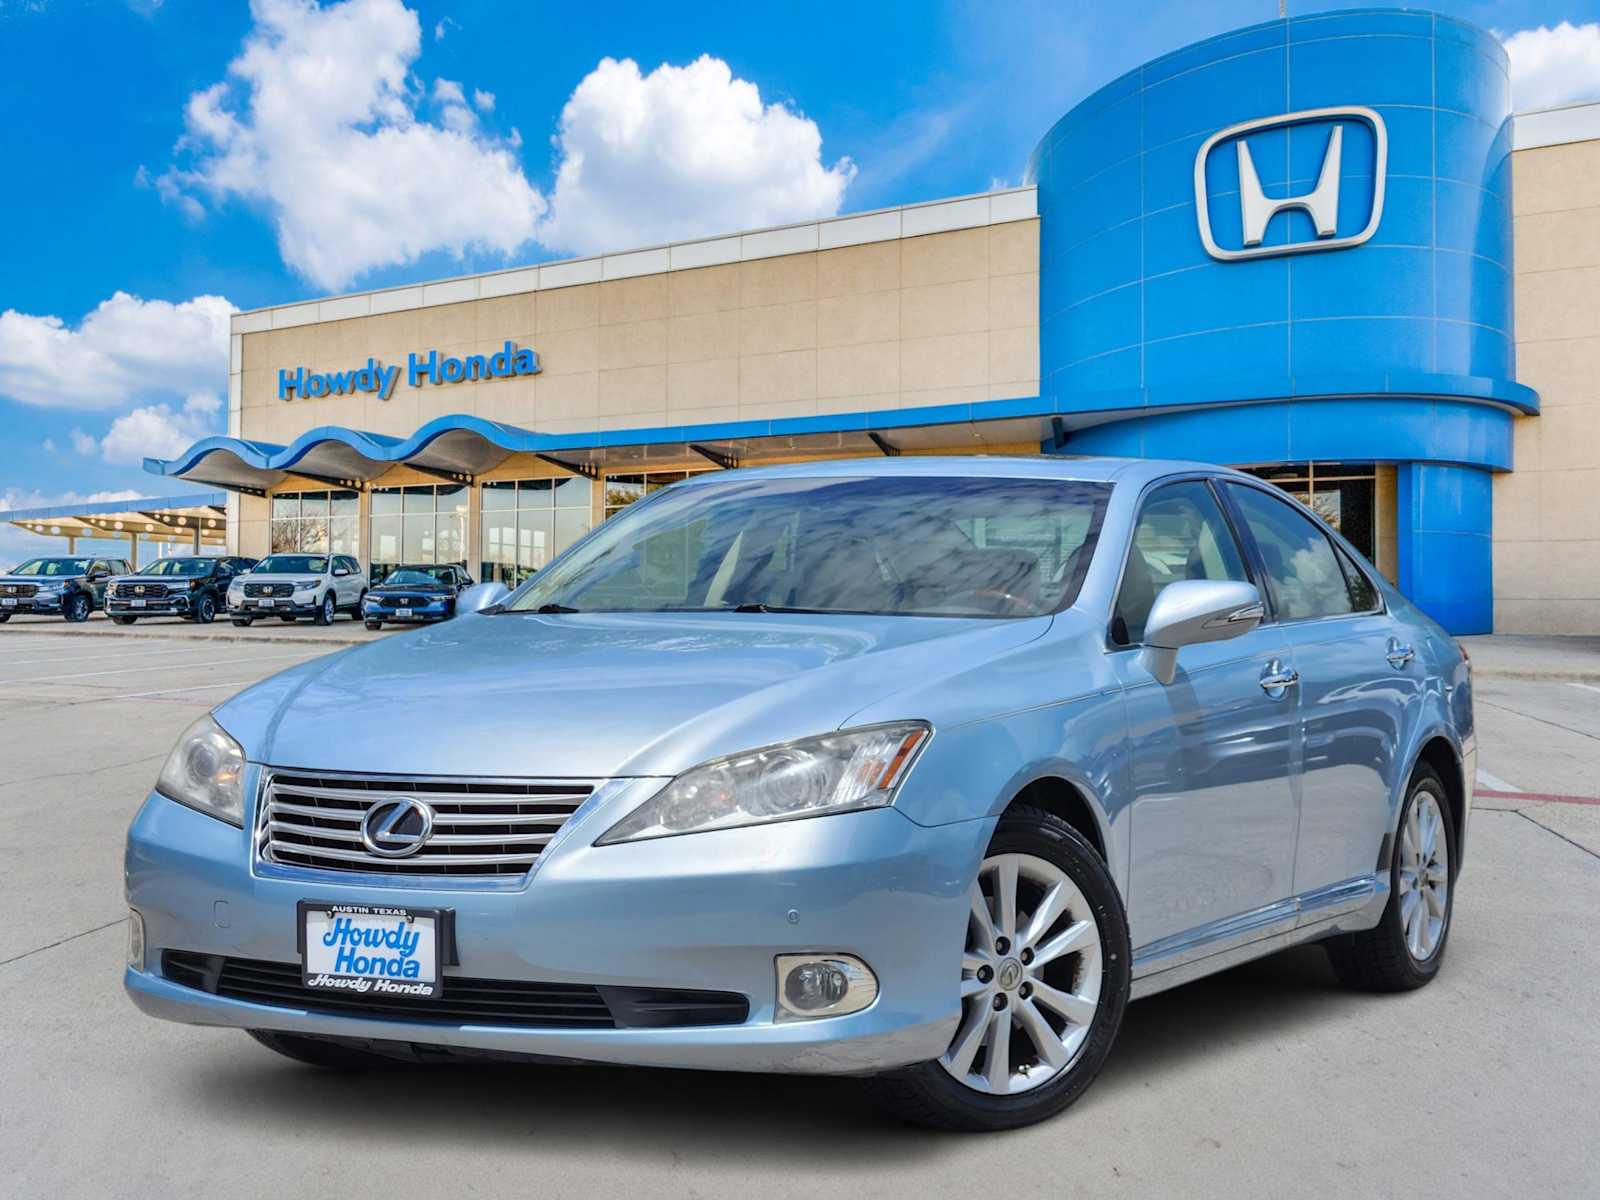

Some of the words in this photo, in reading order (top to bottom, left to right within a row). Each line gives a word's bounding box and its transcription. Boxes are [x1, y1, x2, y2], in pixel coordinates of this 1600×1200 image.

[278, 357, 400, 400] Howdy
[407, 340, 541, 387] Honda
[332, 905, 369, 913] AUSTIN
[323, 917, 419, 957] Howdy
[335, 946, 419, 977] Honda
[308, 974, 372, 992] Howdy
[374, 979, 433, 995] Honda
